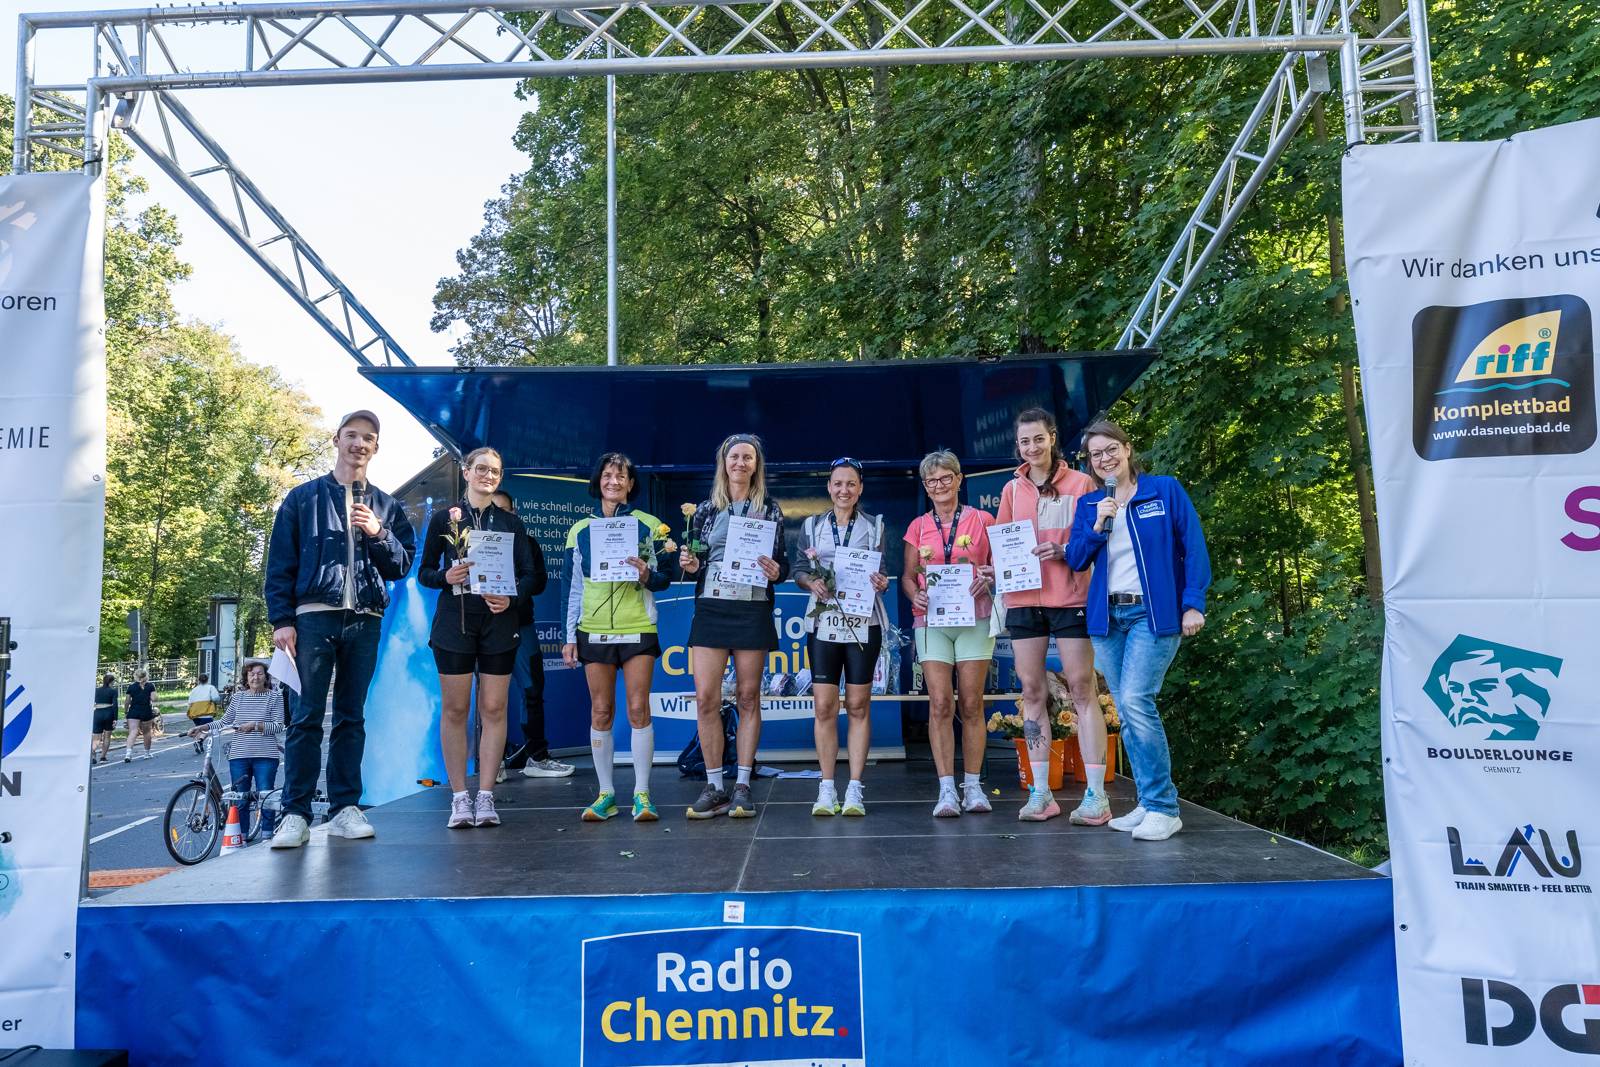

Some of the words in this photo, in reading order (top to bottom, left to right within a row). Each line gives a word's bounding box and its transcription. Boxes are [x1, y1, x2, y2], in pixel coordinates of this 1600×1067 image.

[1402, 258, 1445, 279] Wir
[1451, 253, 1544, 279] danken
[1475, 341, 1551, 376] riff
[1433, 396, 1571, 422] Komplettbad
[1433, 422, 1571, 441] www.dasneuebad.de
[523, 500, 539, 510] wie
[540, 501, 572, 513] schnell
[574, 503, 595, 514] oder
[518, 513, 547, 524] elche
[544, 528, 560, 538] sich
[827, 615, 862, 628] 10152
[660, 697, 692, 713] Wir
[1427, 747, 1573, 762] BOULDERLOUNGE
[1483, 765, 1522, 775] CHEMNITZ
[1447, 825, 1582, 878] LAU
[1455, 881, 1486, 891] TRAIN
[1488, 882, 1531, 893] SMARTER
[1542, 884, 1563, 893] FEEL
[1565, 884, 1593, 894] BETTER
[657, 946, 793, 993] Radio
[601, 993, 849, 1043] Chemnitz.
